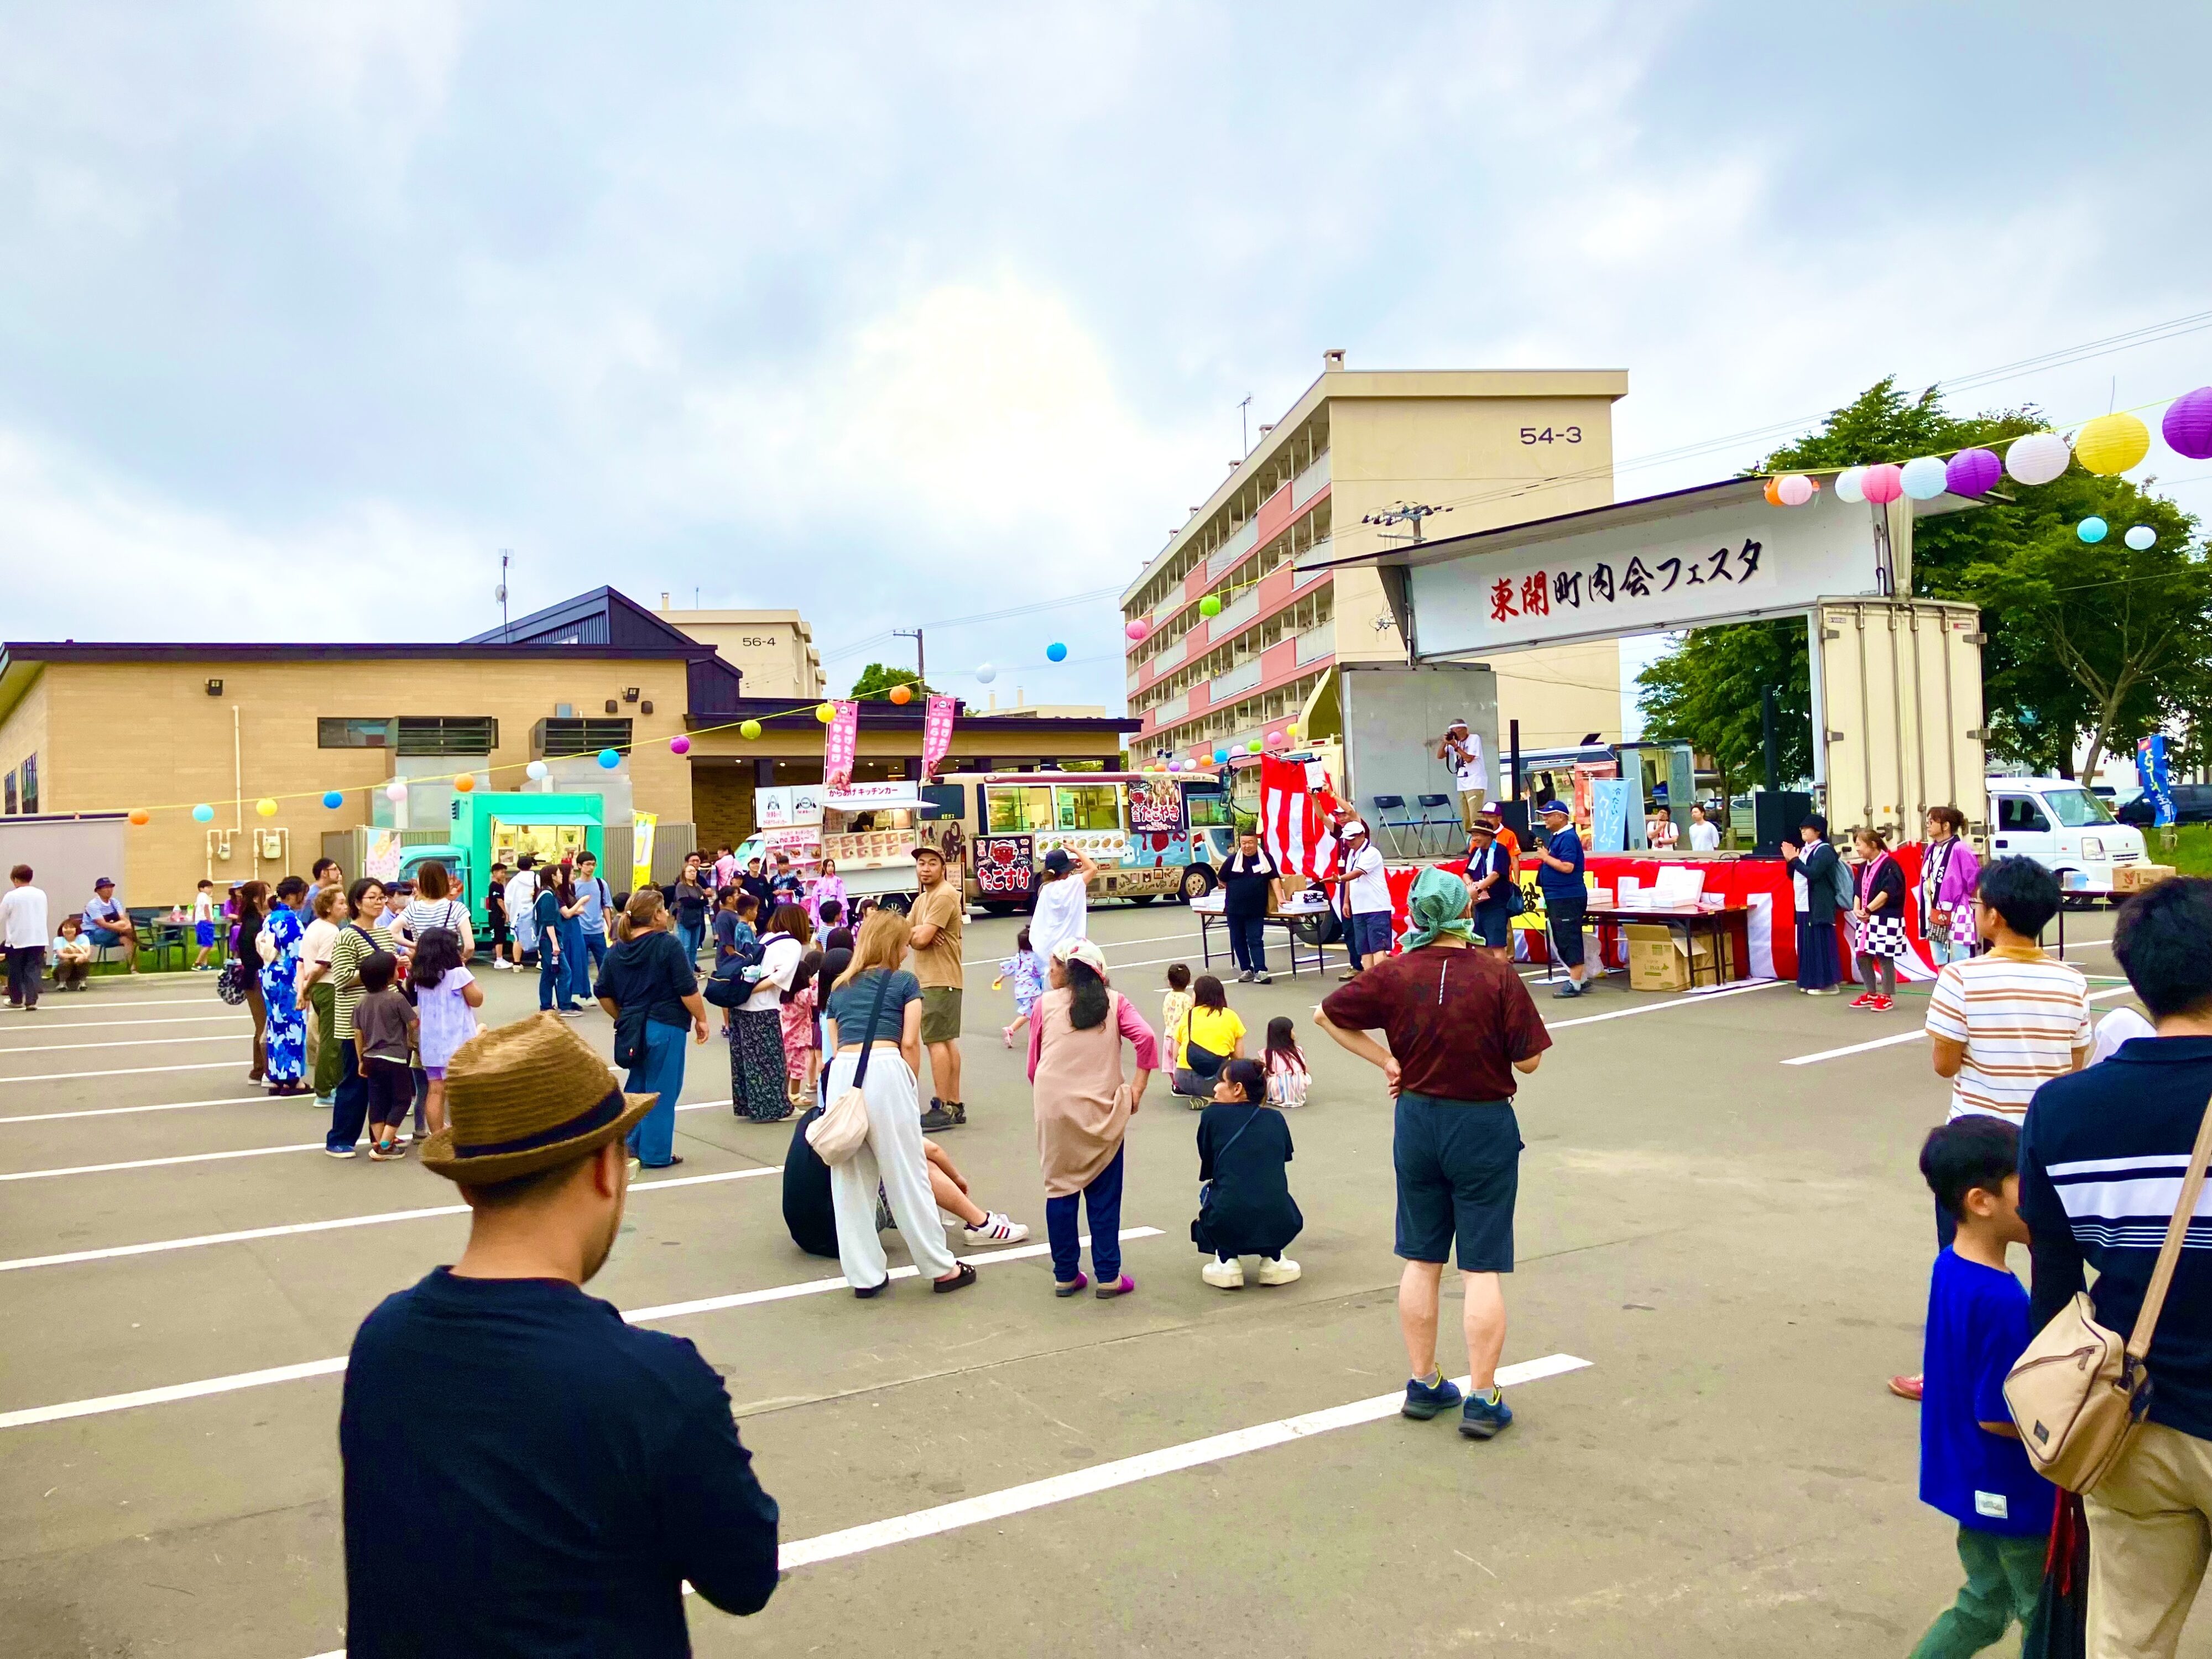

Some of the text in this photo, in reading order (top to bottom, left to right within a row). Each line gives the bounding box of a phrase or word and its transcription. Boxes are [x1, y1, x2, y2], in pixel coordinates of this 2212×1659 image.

[1520, 426, 1582, 445] 54-3
[1490, 538, 1763, 622] 東開町内会フェスタ
[743, 637, 776, 646] 56-4
[858, 787, 898, 796] キッチンカー
[1131, 806, 1140, 822] 大玉
[1141, 805, 1180, 822] たこやき
[1599, 796, 1610, 843] クリーム
[978, 866, 1031, 890] たこすけ
